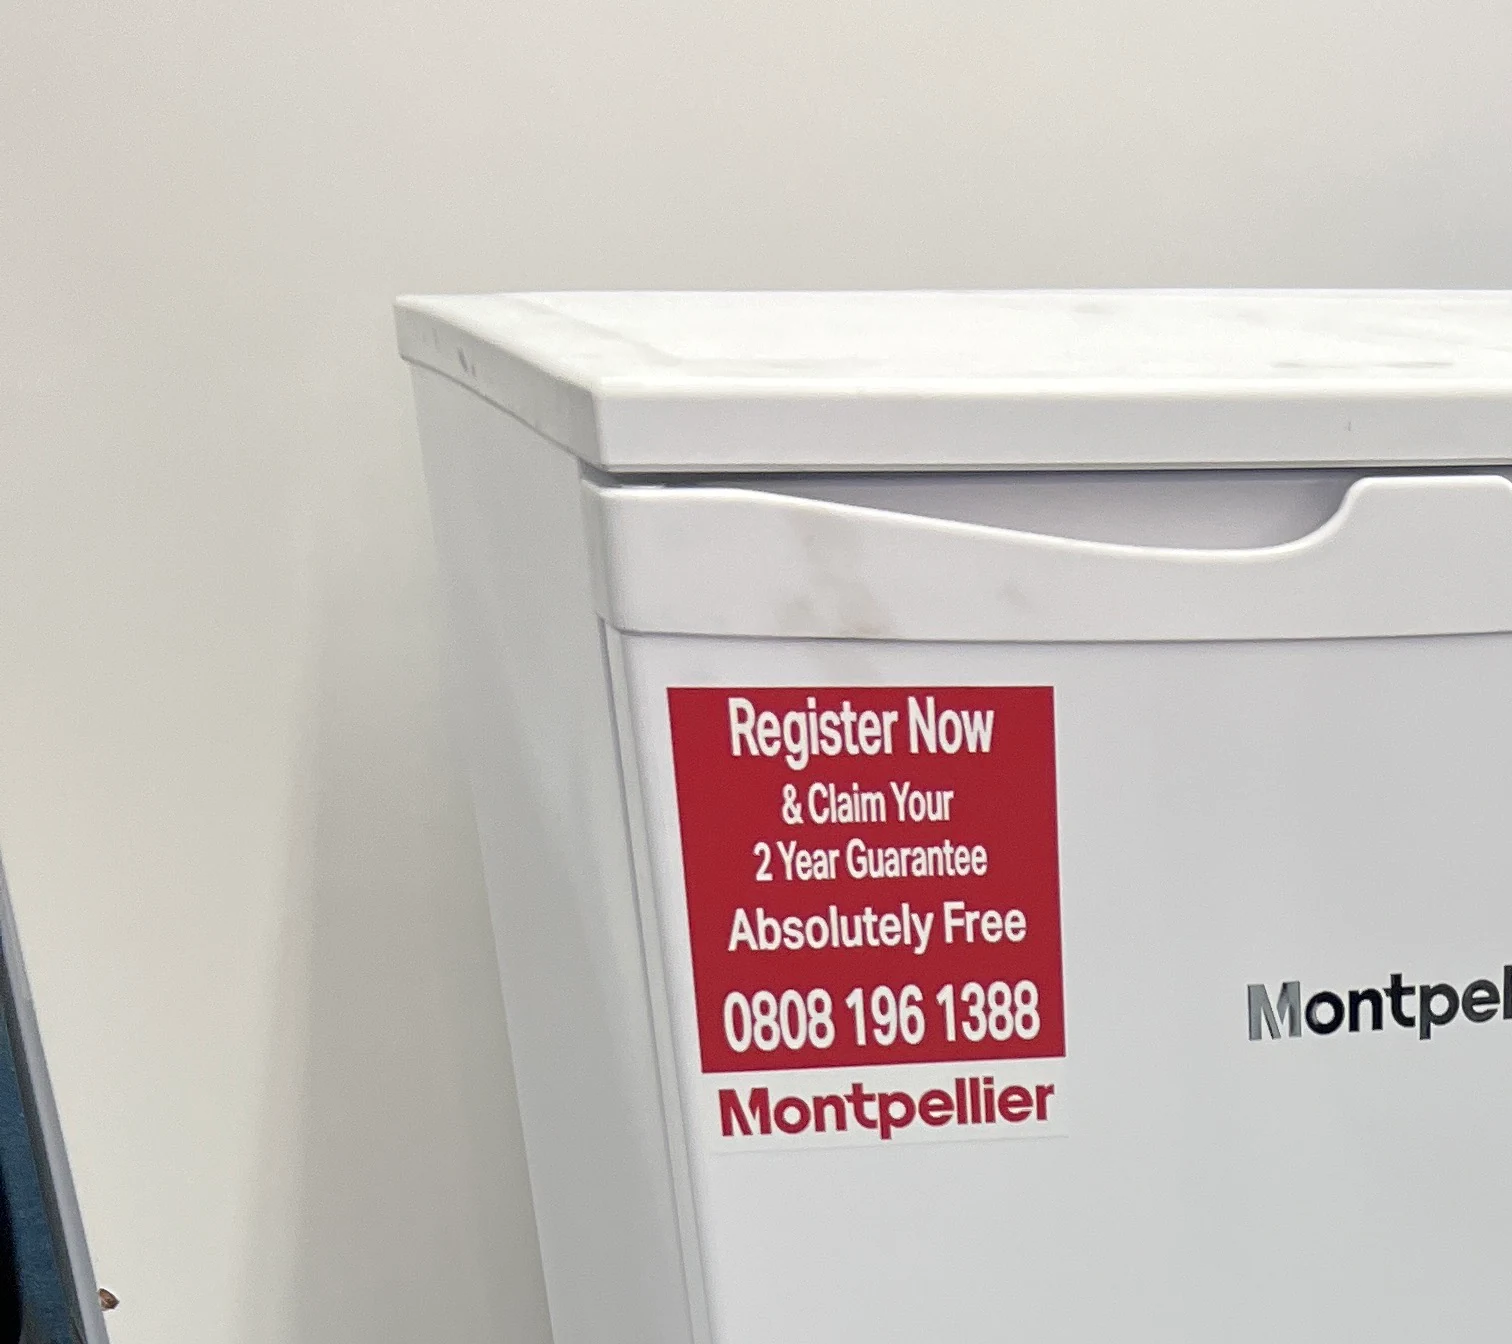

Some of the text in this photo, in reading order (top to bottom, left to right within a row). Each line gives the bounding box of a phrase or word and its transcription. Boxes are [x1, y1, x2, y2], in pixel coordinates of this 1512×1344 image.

[727, 695, 996, 771] Register Now
[781, 780, 955, 826] & Claim Your
[752, 837, 988, 883] 2 Year Guarantee
[727, 900, 1028, 956] Absolutely Free
[722, 979, 1042, 1054] 0808 196 1388
[717, 1075, 1056, 1141] Montpellier
